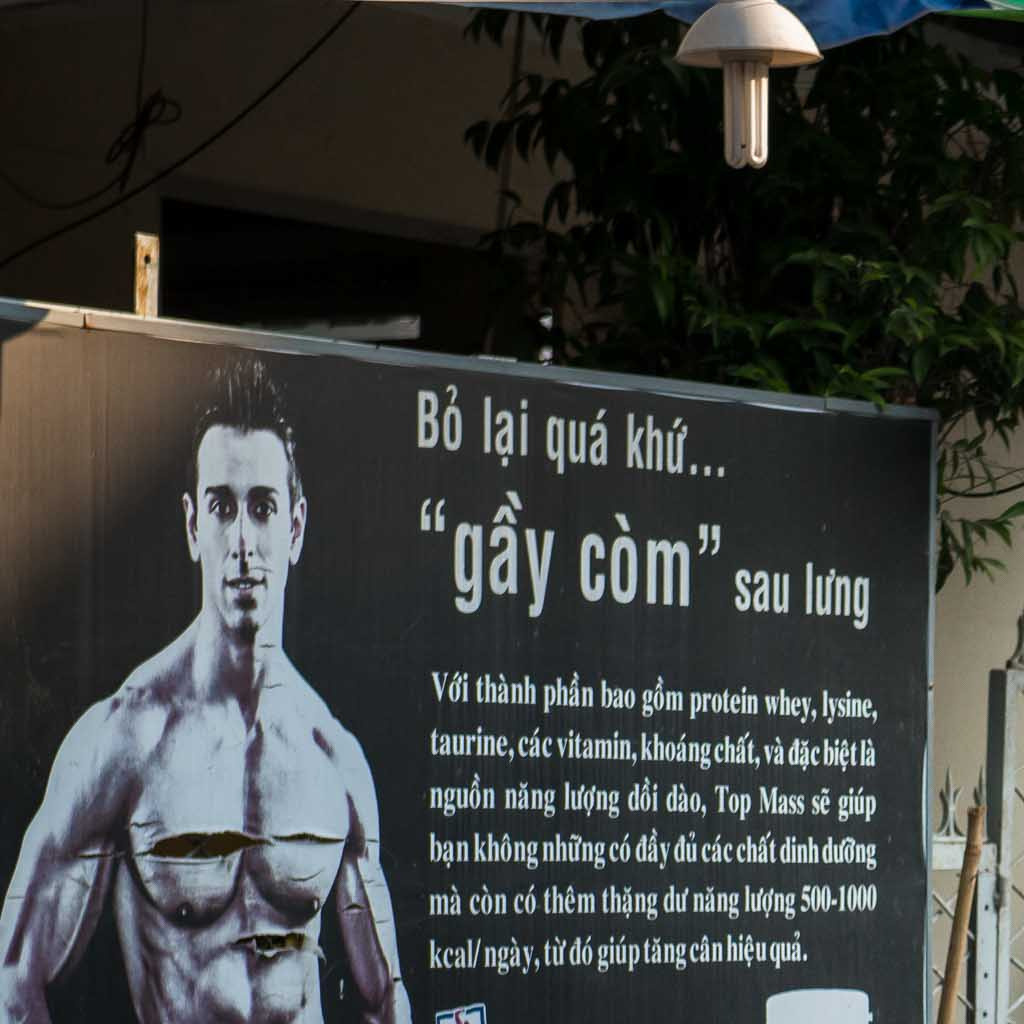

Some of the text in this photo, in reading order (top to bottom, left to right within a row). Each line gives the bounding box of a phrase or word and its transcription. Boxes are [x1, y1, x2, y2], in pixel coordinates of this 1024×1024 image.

[417, 384, 726, 477] Bỏ lại quá khứ...
[420, 491, 870, 630] “gầy còm” sau lưng
[431, 671, 878, 725] Với thành phần bao gồm protein whey, lysine,
[430, 725, 876, 773] taurine, các vitamin, khoáng chất, và đặc biệt là
[430, 772, 877, 822] nguồn năng lượng dồi dào, Top Mass sẽ giúp
[429, 828, 877, 870] bạn không những có đầy đủ các chất dinh dưỡng
[429, 884, 878, 920] mà còn có thêm thặng dư năng lượng 500-1000
[544, 936, 567, 966] từ
[569, 936, 593, 966] đó
[597, 934, 641, 972] giúp
[644, 937, 687, 971] tăng
[689, 936, 723, 963] cân
[726, 934, 767, 968] hiệu
[769, 931, 808, 969] quả.
